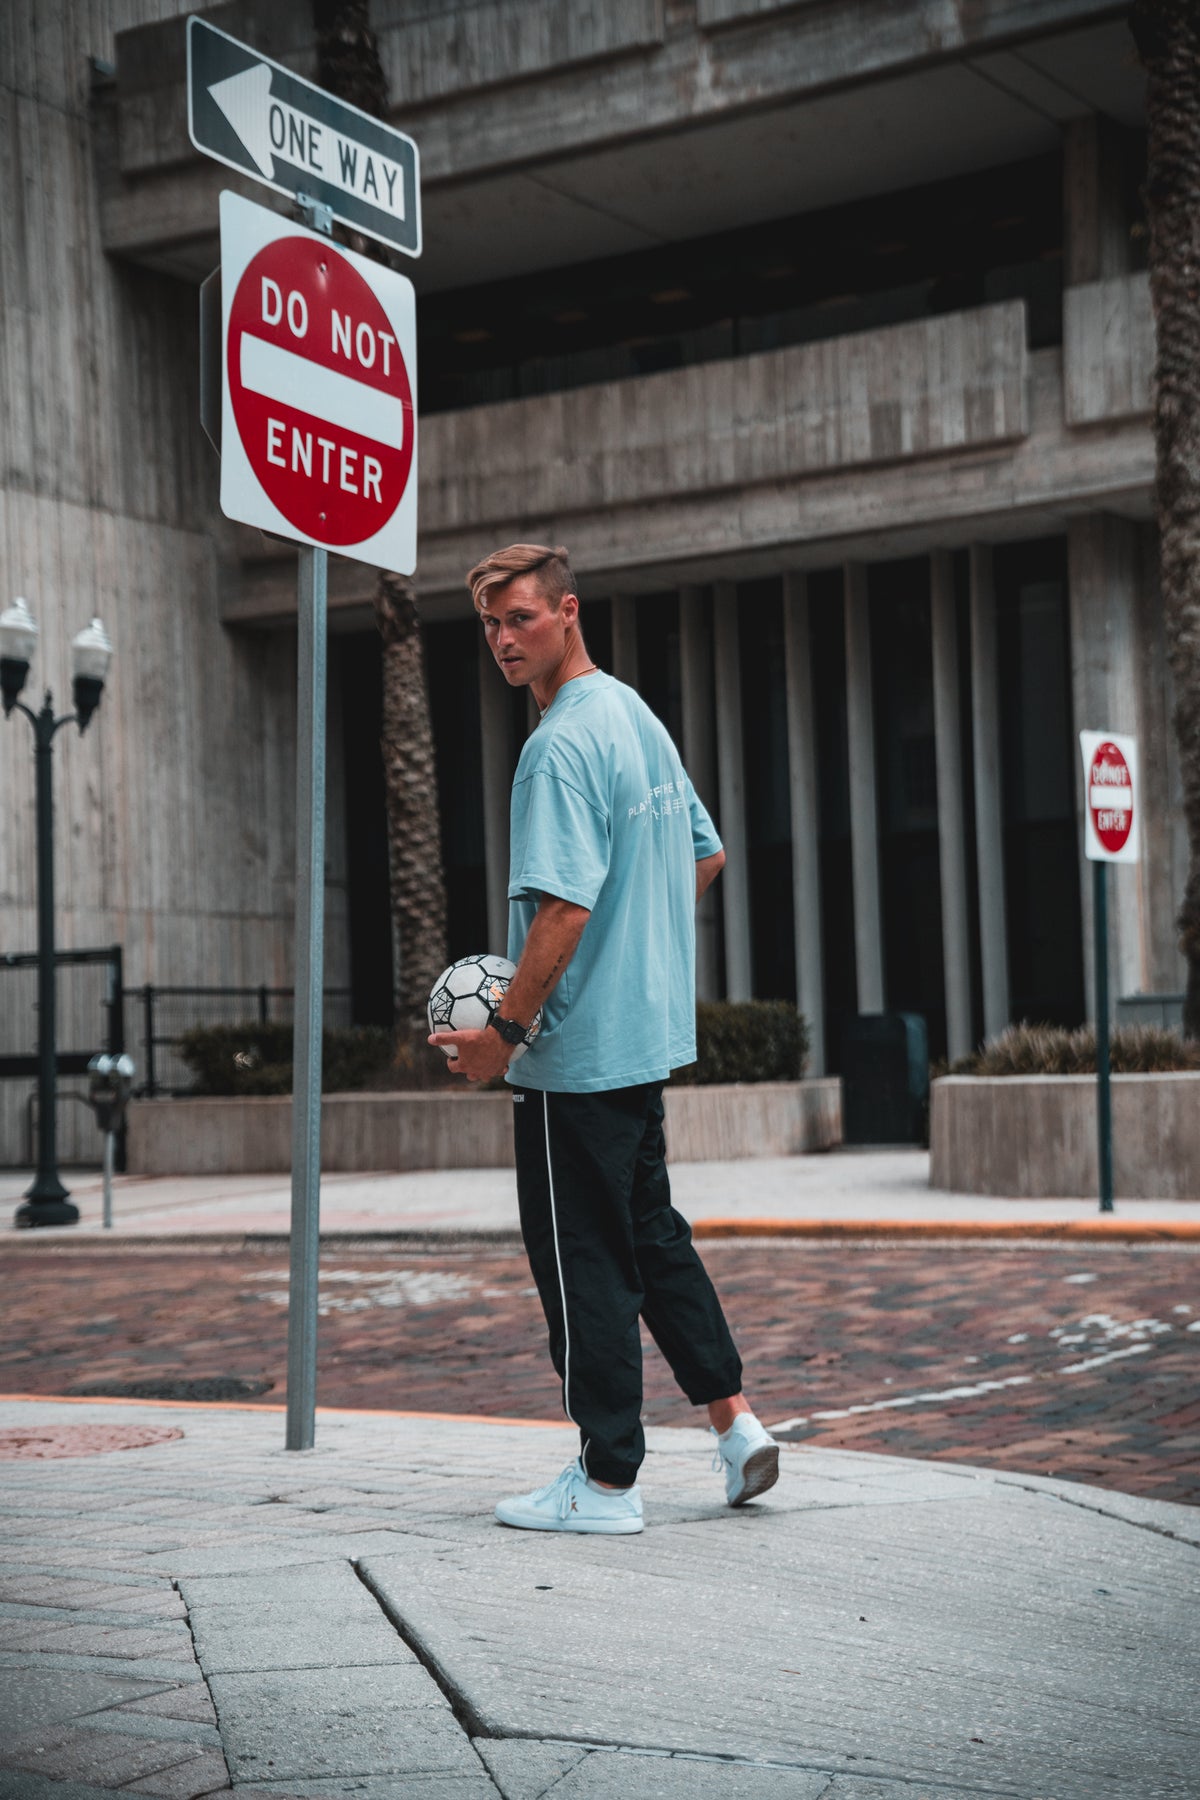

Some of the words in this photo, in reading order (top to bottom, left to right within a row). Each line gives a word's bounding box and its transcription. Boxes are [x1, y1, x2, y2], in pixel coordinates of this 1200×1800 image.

[270, 104, 322, 172] ONE
[337, 139, 397, 207] WAY
[261, 276, 308, 338] DO
[331, 308, 395, 377] NOT
[266, 417, 383, 504] ENTER
[1097, 809, 1126, 831] ENTER
